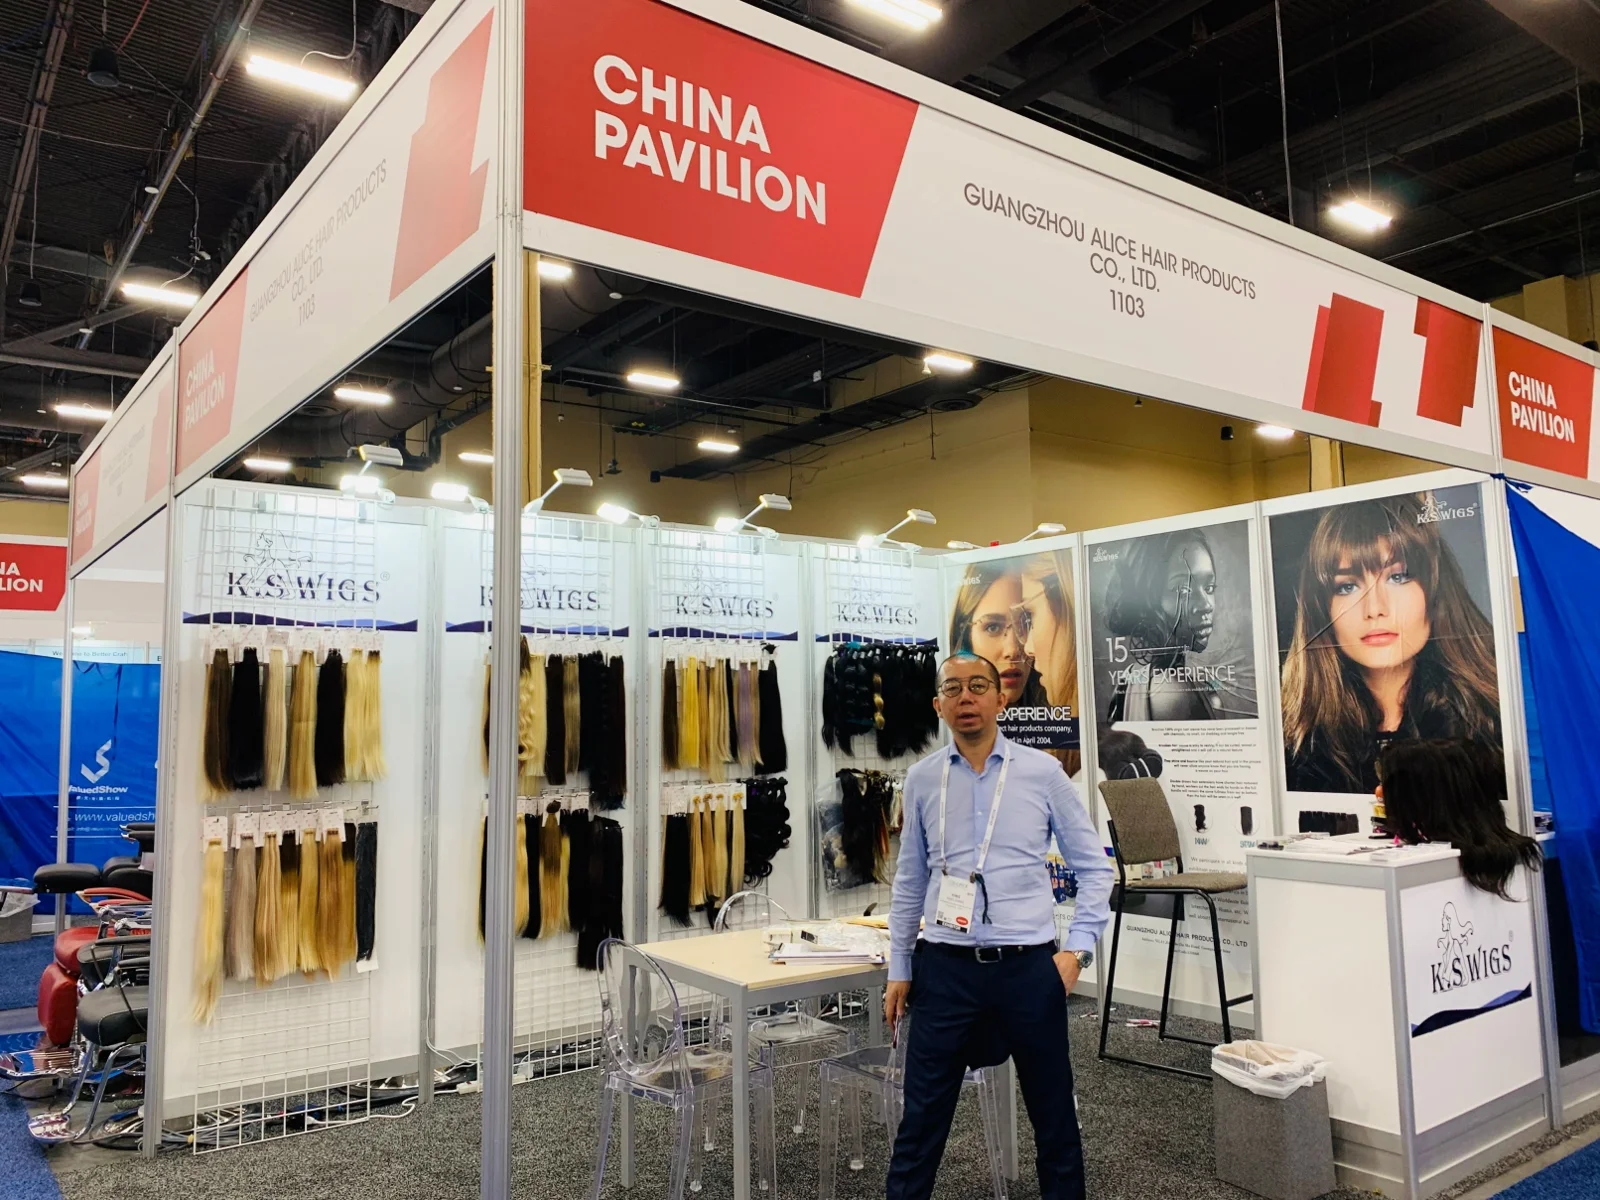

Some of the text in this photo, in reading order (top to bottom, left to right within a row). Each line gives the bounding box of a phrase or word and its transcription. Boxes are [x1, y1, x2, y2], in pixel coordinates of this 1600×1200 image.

[593, 54, 772, 154] CHINA
[594, 109, 827, 226] PAVILION
[250, 158, 387, 323] GUANGZHOU ALICE HAIR PRODUCTS
[963, 182, 1256, 300] GUANGZHOU ALICE HAIR PRODUCTS
[1090, 252, 1160, 293] CO., LTD.
[299, 293, 316, 326] 1103
[1110, 289, 1145, 318] 1103
[185, 348, 215, 398] CHINA
[1508, 370, 1558, 410] CHINA
[184, 371, 226, 432] PAVILION
[1510, 400, 1575, 444] PAVILION
[1441, 507, 1475, 520] WIGS
[1105, 636, 1128, 663] 15
[1108, 665, 1237, 686] YEARS EXPERIENCE
[996, 706, 1072, 721] EXPERIENCE
[1008, 724, 1019, 732] hair
[1019, 725, 1044, 733] products
[1044, 726, 1073, 734] company,
[1023, 737, 1036, 745] April
[75, 812, 156, 821] www.valuedsh
[1126, 925, 1158, 935] GUANGZHOU
[1159, 929, 1171, 937] ALIC
[1192, 934, 1214, 942] PRODUC
[1466, 944, 1512, 982] WIGS
